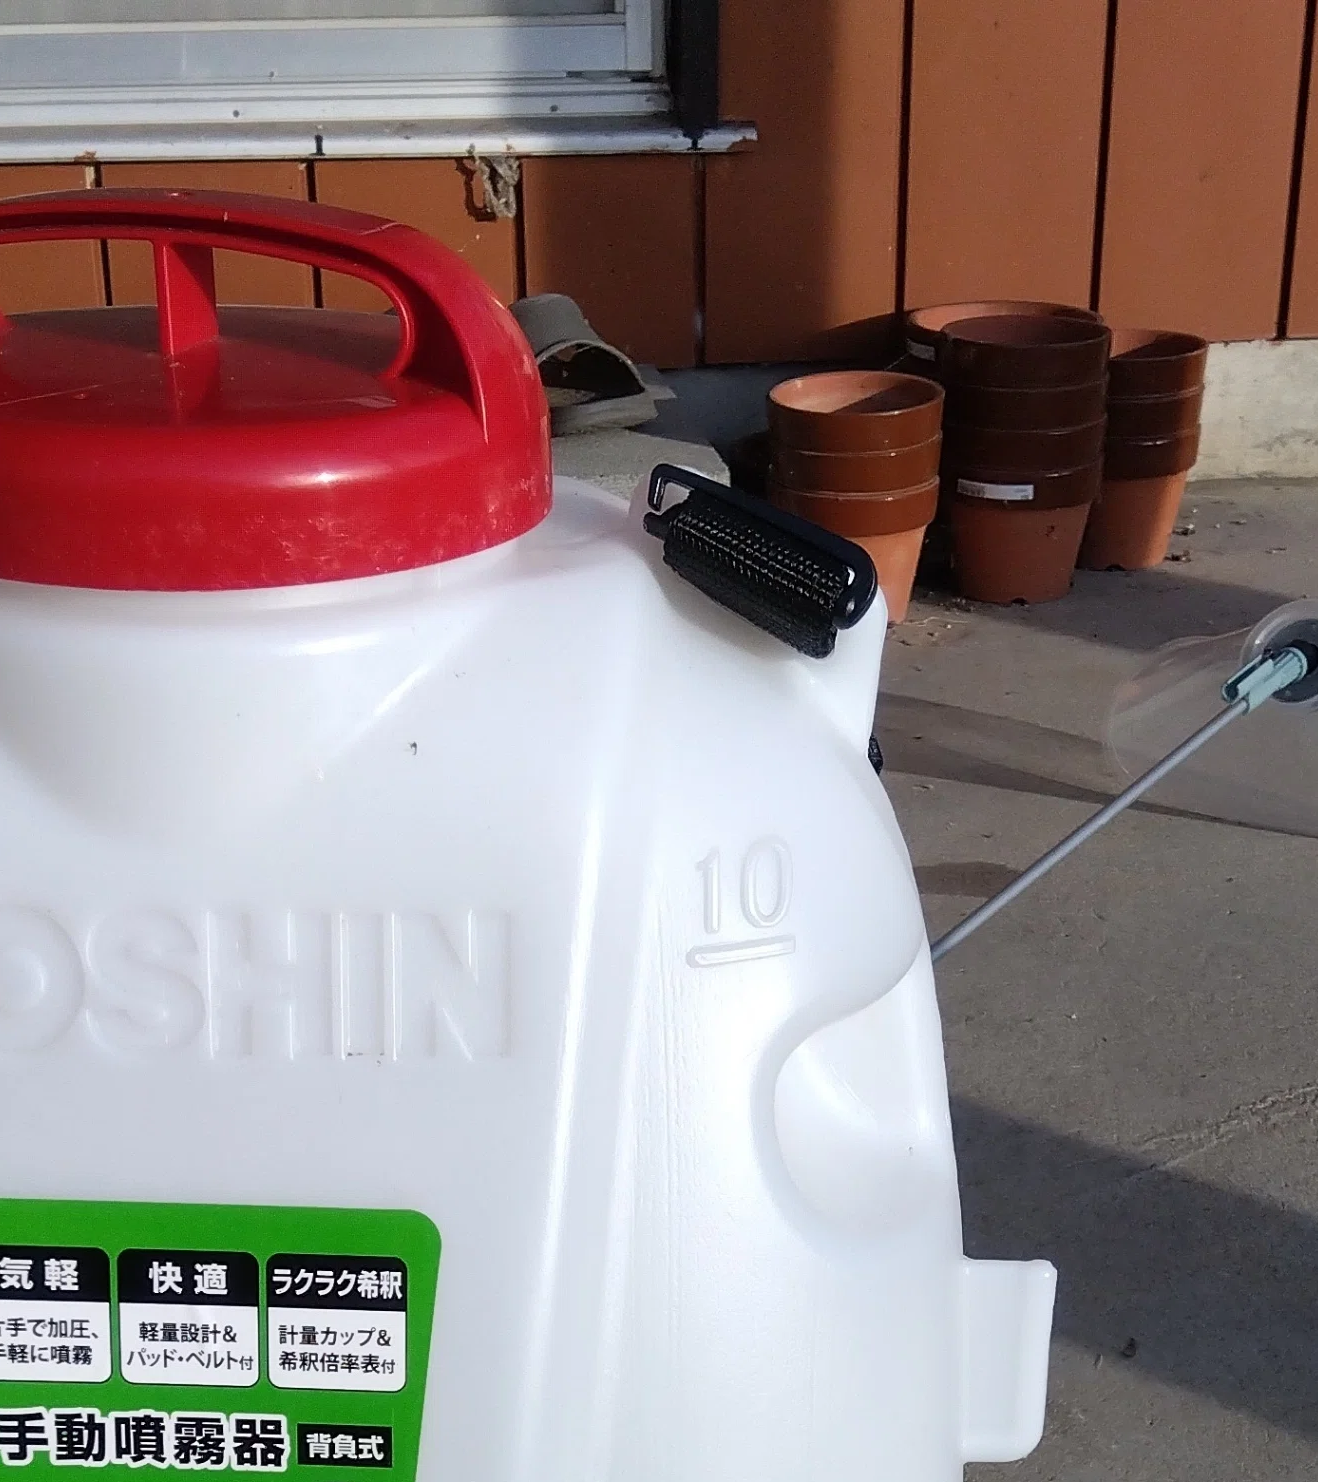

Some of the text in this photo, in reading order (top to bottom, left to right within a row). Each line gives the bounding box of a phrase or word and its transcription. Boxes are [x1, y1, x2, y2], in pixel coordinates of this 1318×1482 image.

[691, 838, 795, 936] 10
[148, 1261, 229, 1296] 快適
[271, 1268, 404, 1301] ラクラク希釈
[138, 1320, 238, 1345] 軽量設計&
[277, 1324, 392, 1349] 計量カップ&
[278, 1351, 396, 1376] 希釈倍率表付
[305, 1431, 385, 1463] 背負式
